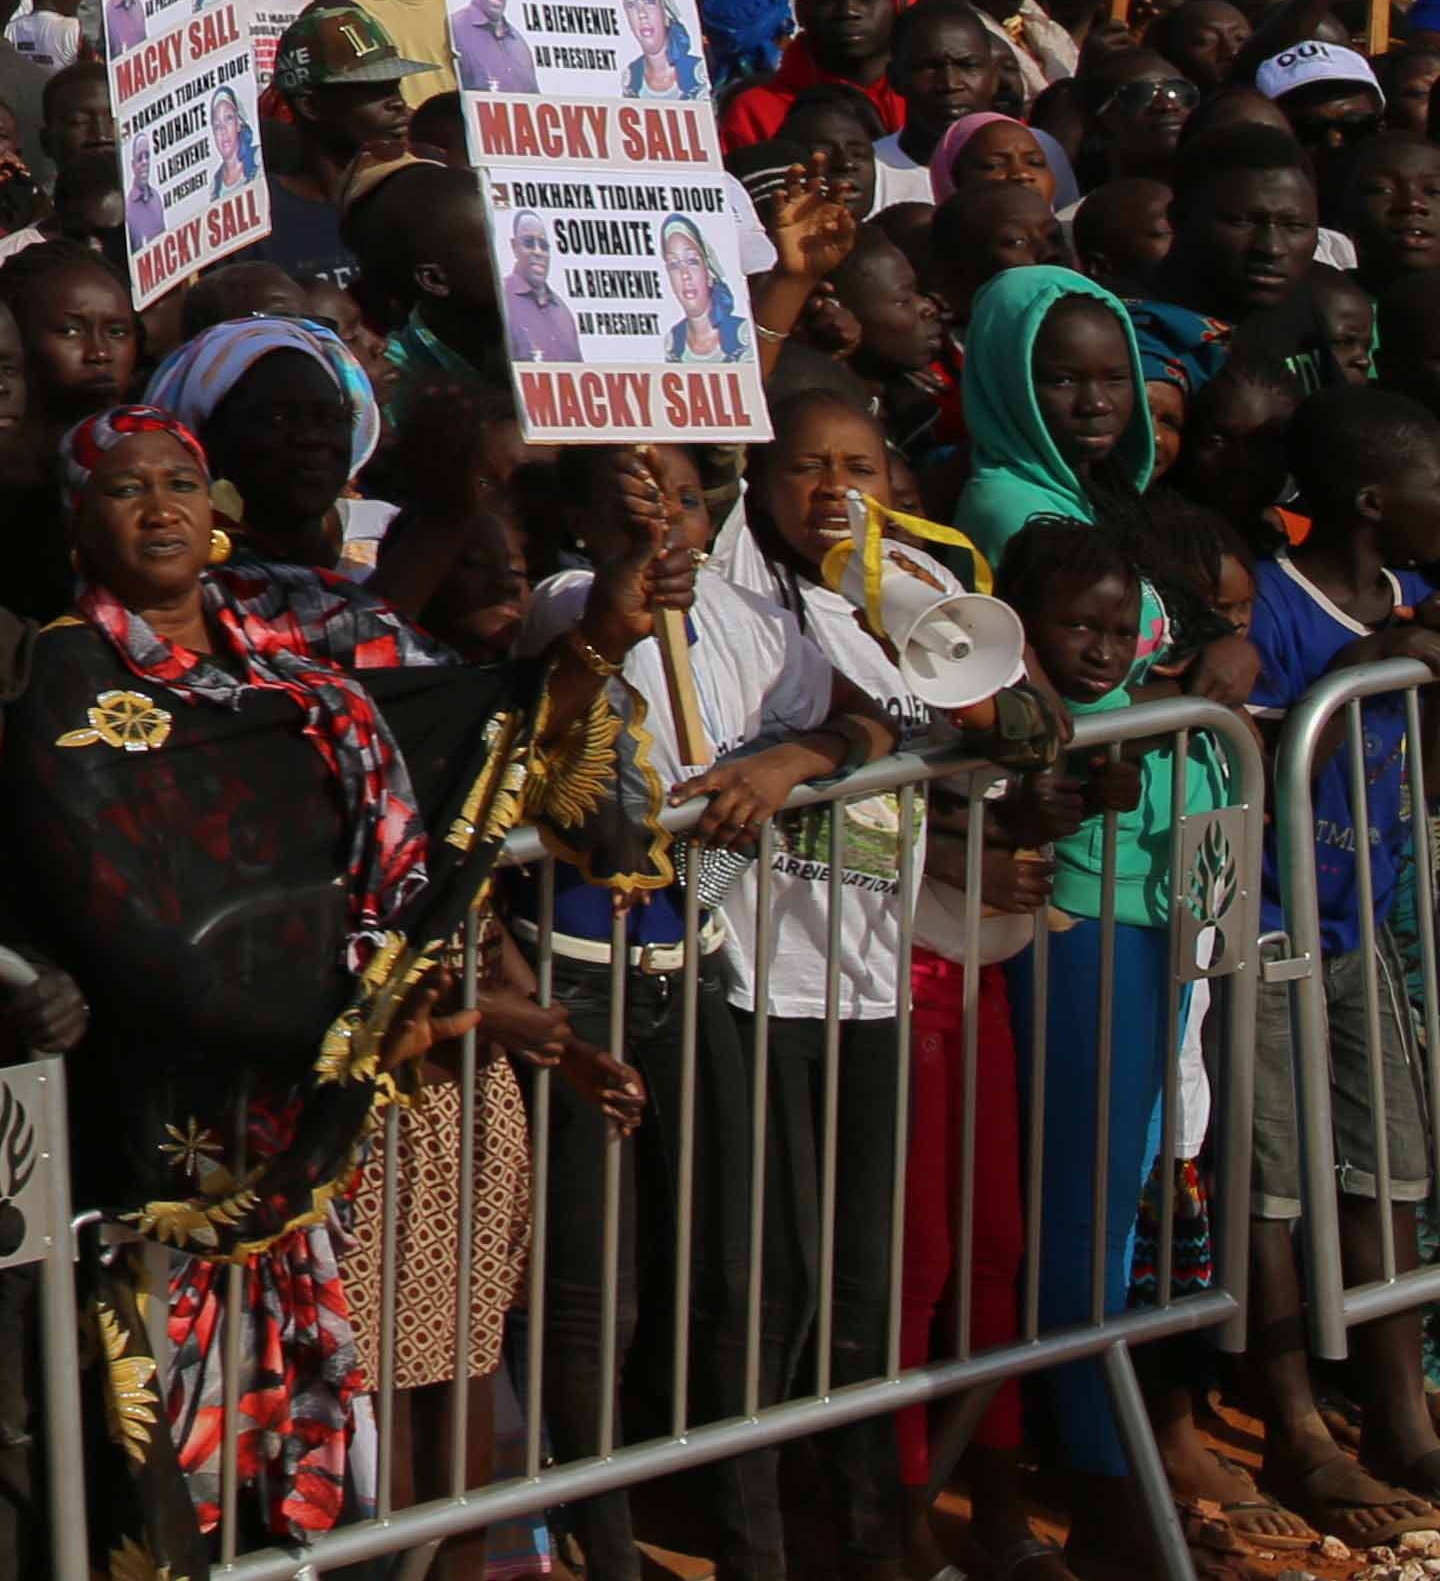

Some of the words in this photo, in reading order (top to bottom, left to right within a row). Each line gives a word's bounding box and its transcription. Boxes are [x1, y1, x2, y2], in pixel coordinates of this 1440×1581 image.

[523, 4, 540, 30] LA
[543, 4, 620, 36] BIENVENUE
[115, 28, 183, 104] MACKY
[191, 4, 239, 63] SALL
[535, 46, 553, 67] AU
[555, 47, 617, 71] PRESIDENT
[1276, 45, 1330, 67] OUI
[133, 97, 174, 134] ROKHAYA
[176, 71, 216, 115] TIDIANE
[218, 53, 250, 87] DIOUF
[152, 102, 207, 154] SOUHAITE
[476, 102, 609, 160] MACKY
[622, 107, 708, 162] SALL
[157, 162, 167, 183] LA
[167, 141, 209, 179] BIENVENUE
[173, 169, 208, 204] PRESIDENT
[513, 183, 594, 210] ROKHAYA
[596, 185, 669, 211] TIDIANE
[672, 188, 724, 213] DIOUF
[136, 221, 201, 296] MACKY
[208, 191, 260, 251] SALL
[555, 219, 655, 256] SOUHAITE
[565, 270, 583, 298] LA
[585, 270, 663, 300] BIENVENUE
[579, 313, 593, 334] AU
[595, 313, 661, 336] PRESIDENT
[522, 372, 653, 428] MACKY
[664, 373, 751, 428] SALL
